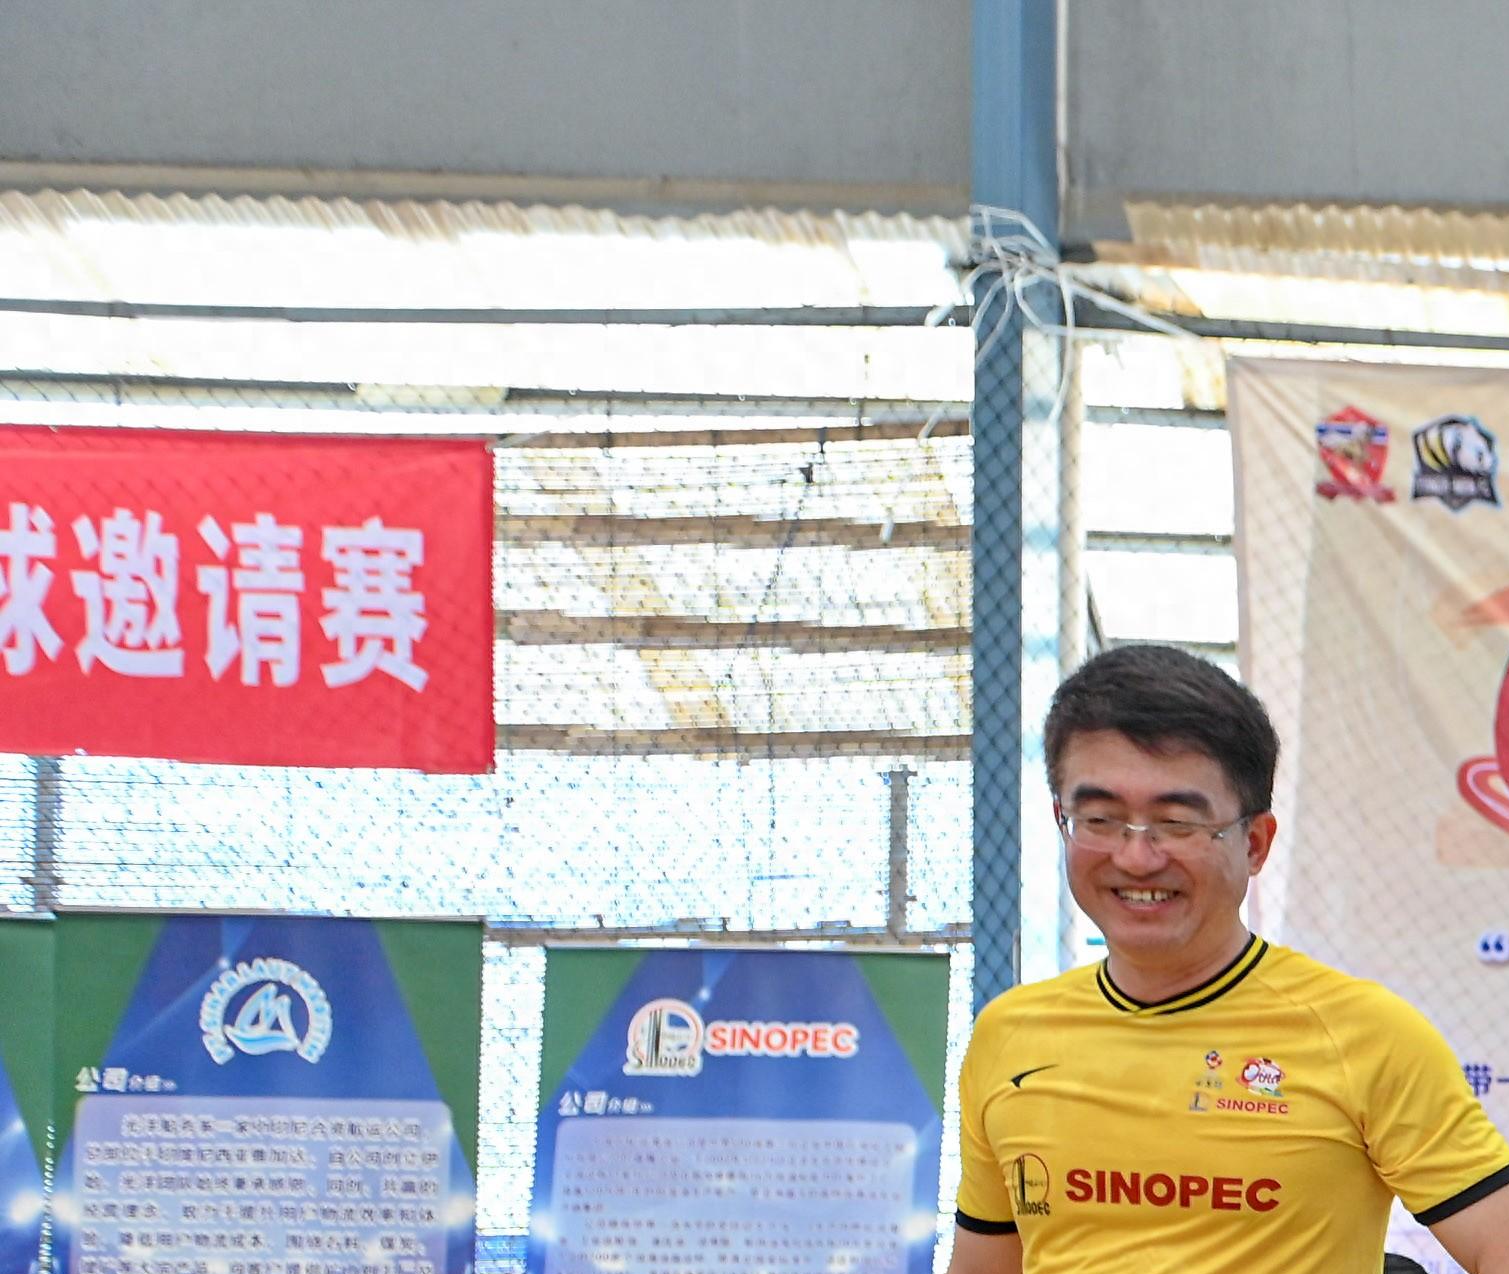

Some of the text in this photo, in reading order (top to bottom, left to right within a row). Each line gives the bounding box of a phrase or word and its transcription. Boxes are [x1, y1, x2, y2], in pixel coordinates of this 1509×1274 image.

[0, 502, 430, 692] 球邀请赛
[707, 1023, 857, 1056] SINOPEC
[1216, 1098, 1290, 1115] SINOPEC
[1066, 1168, 1282, 1213] SINOPEC
